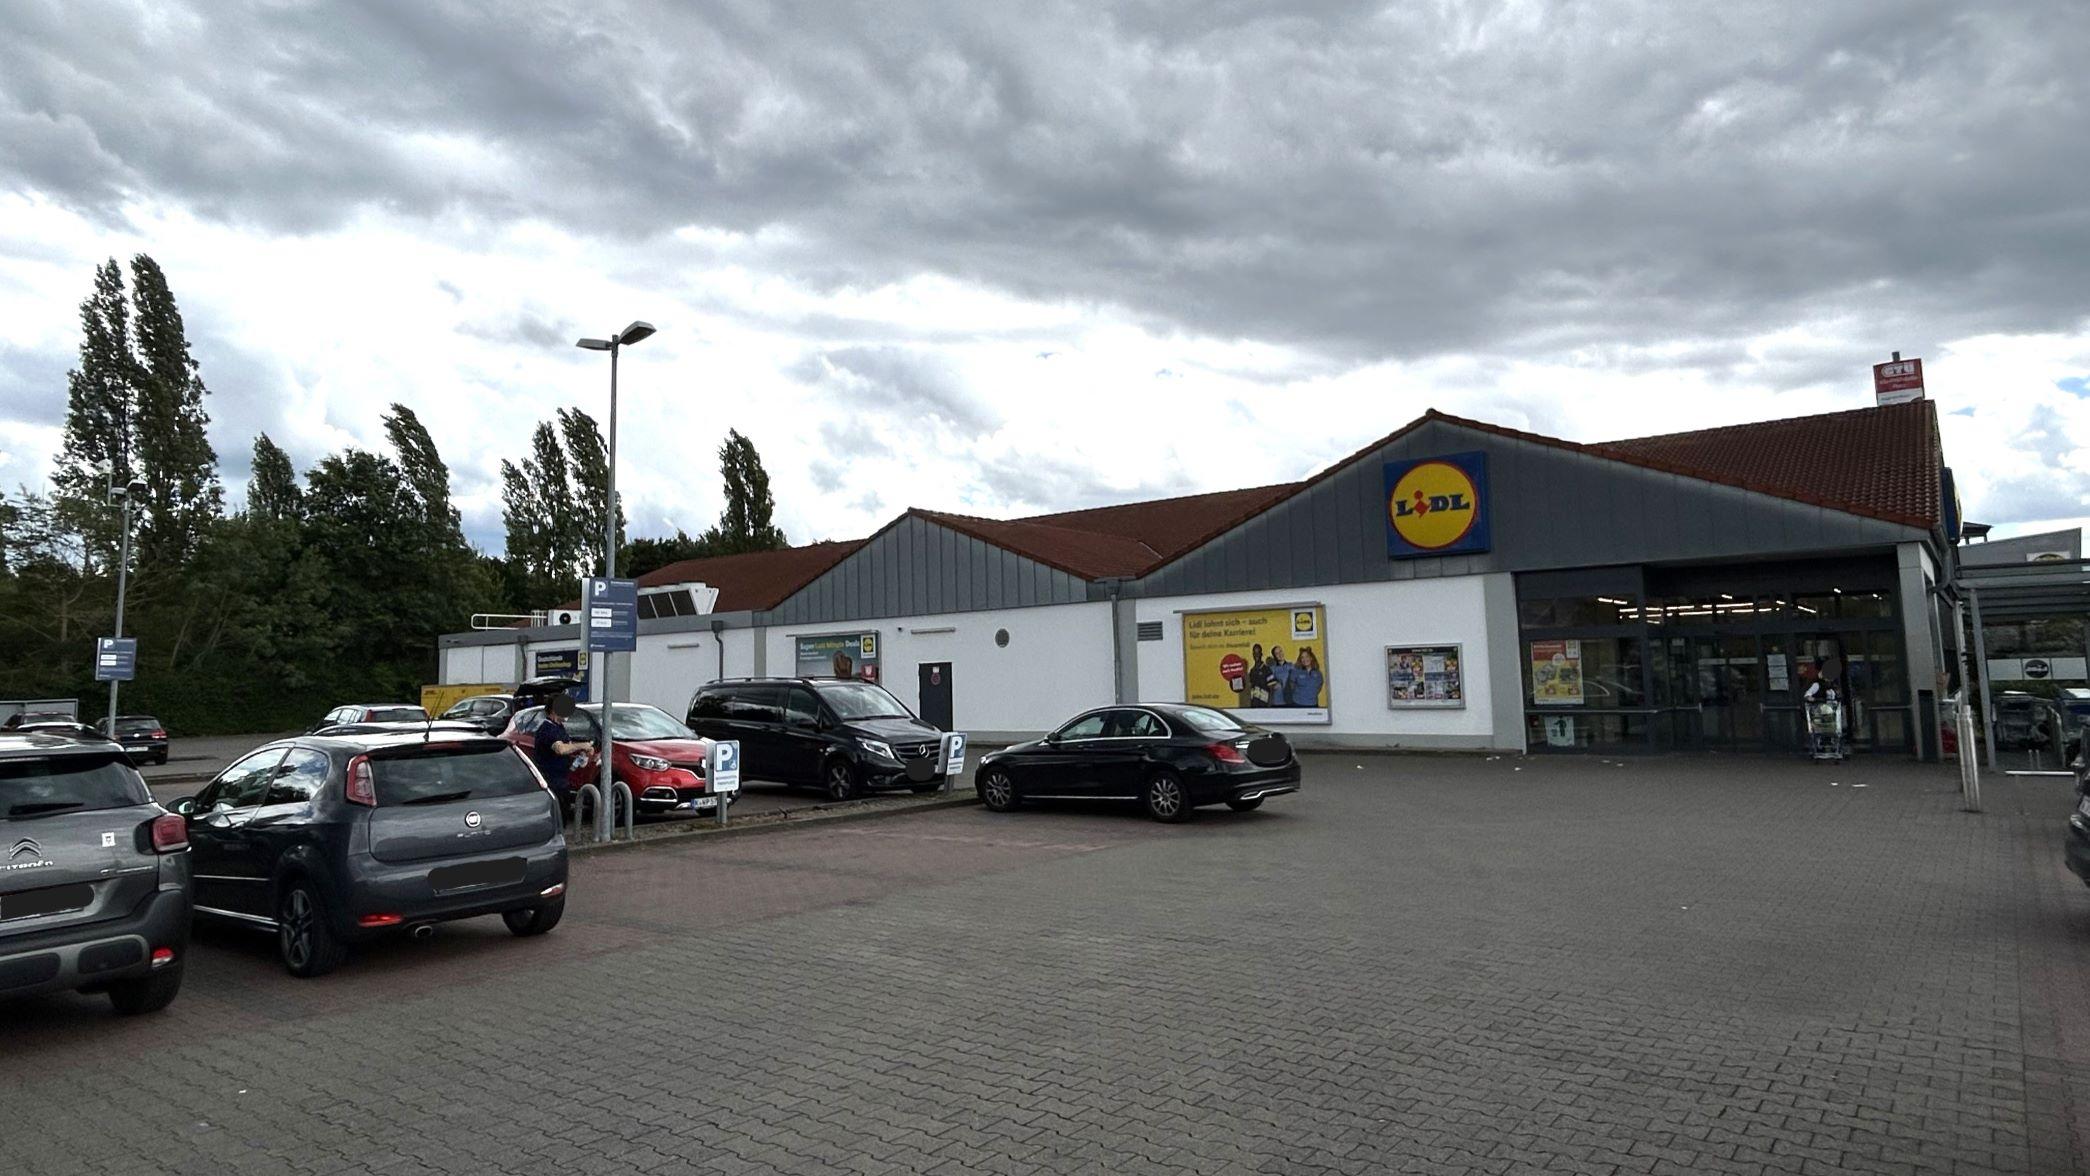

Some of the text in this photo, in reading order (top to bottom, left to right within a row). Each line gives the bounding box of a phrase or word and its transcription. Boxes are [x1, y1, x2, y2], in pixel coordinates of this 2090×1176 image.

[594, 581, 607, 596] P
[1188, 620, 1202, 629] Lidl
[1203, 619, 1224, 628] lohnt
[1225, 617, 1241, 626] sich
[1248, 617, 1268, 625] auch
[1189, 627, 1256, 639] für deine Karriere!
[103, 639, 114, 649] P
[845, 640, 860, 648] Deals
[950, 736, 963, 758] P
[716, 743, 734, 771] P
